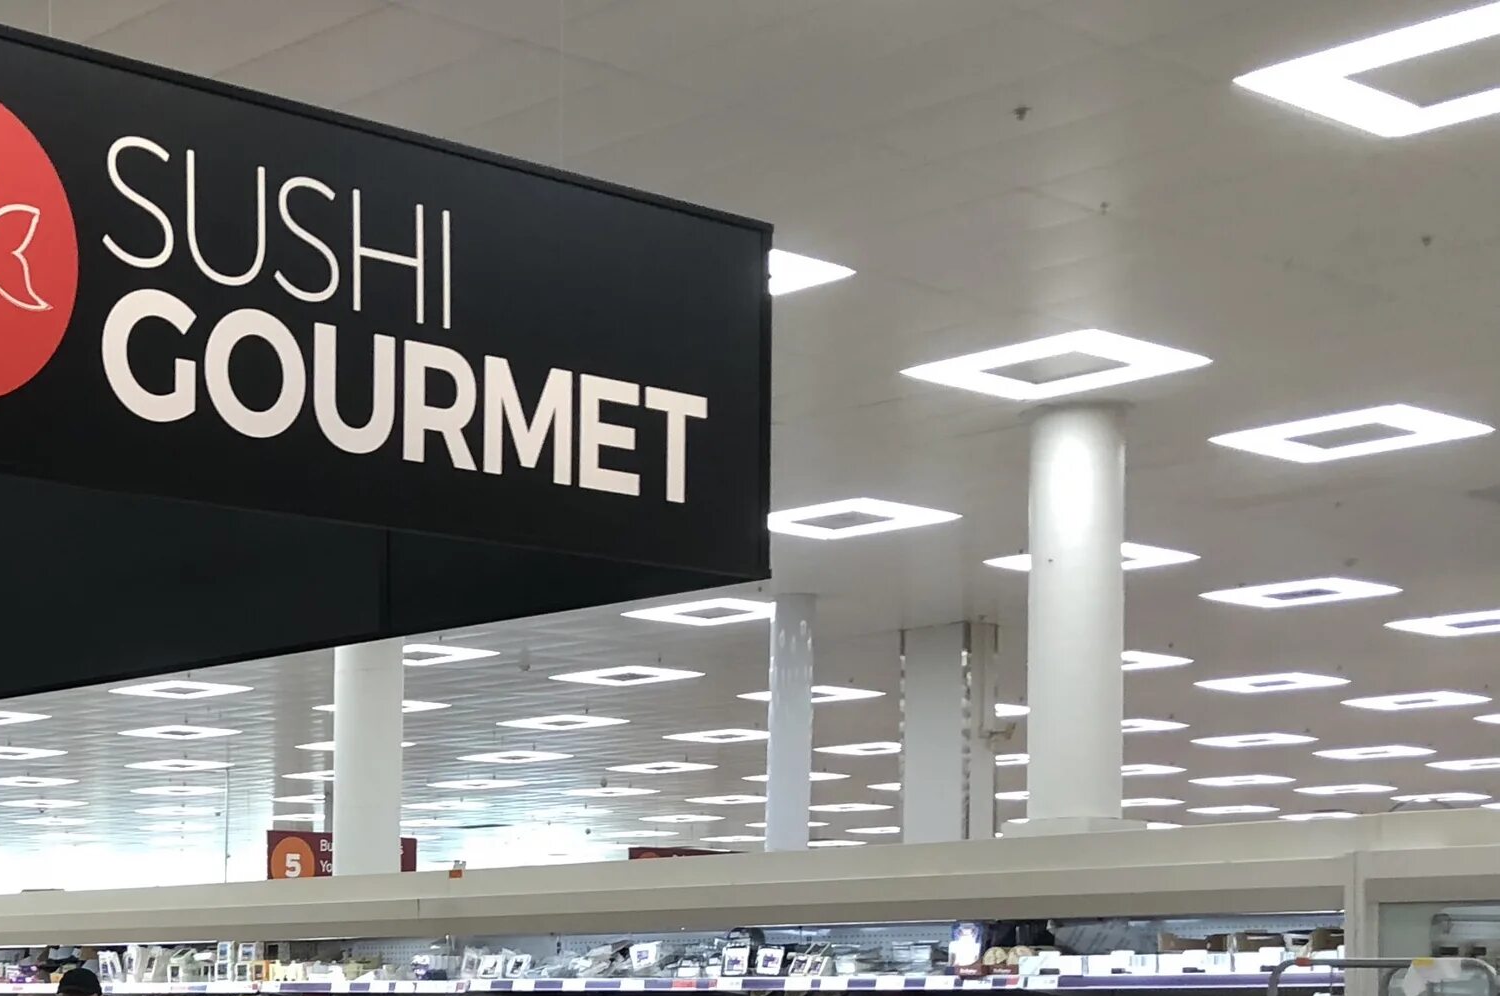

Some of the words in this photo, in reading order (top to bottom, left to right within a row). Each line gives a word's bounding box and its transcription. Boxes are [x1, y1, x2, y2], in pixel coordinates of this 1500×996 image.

[100, 134, 453, 330] SUSHI
[99, 287, 709, 504] GOURMET
[285, 853, 302, 878] 5
